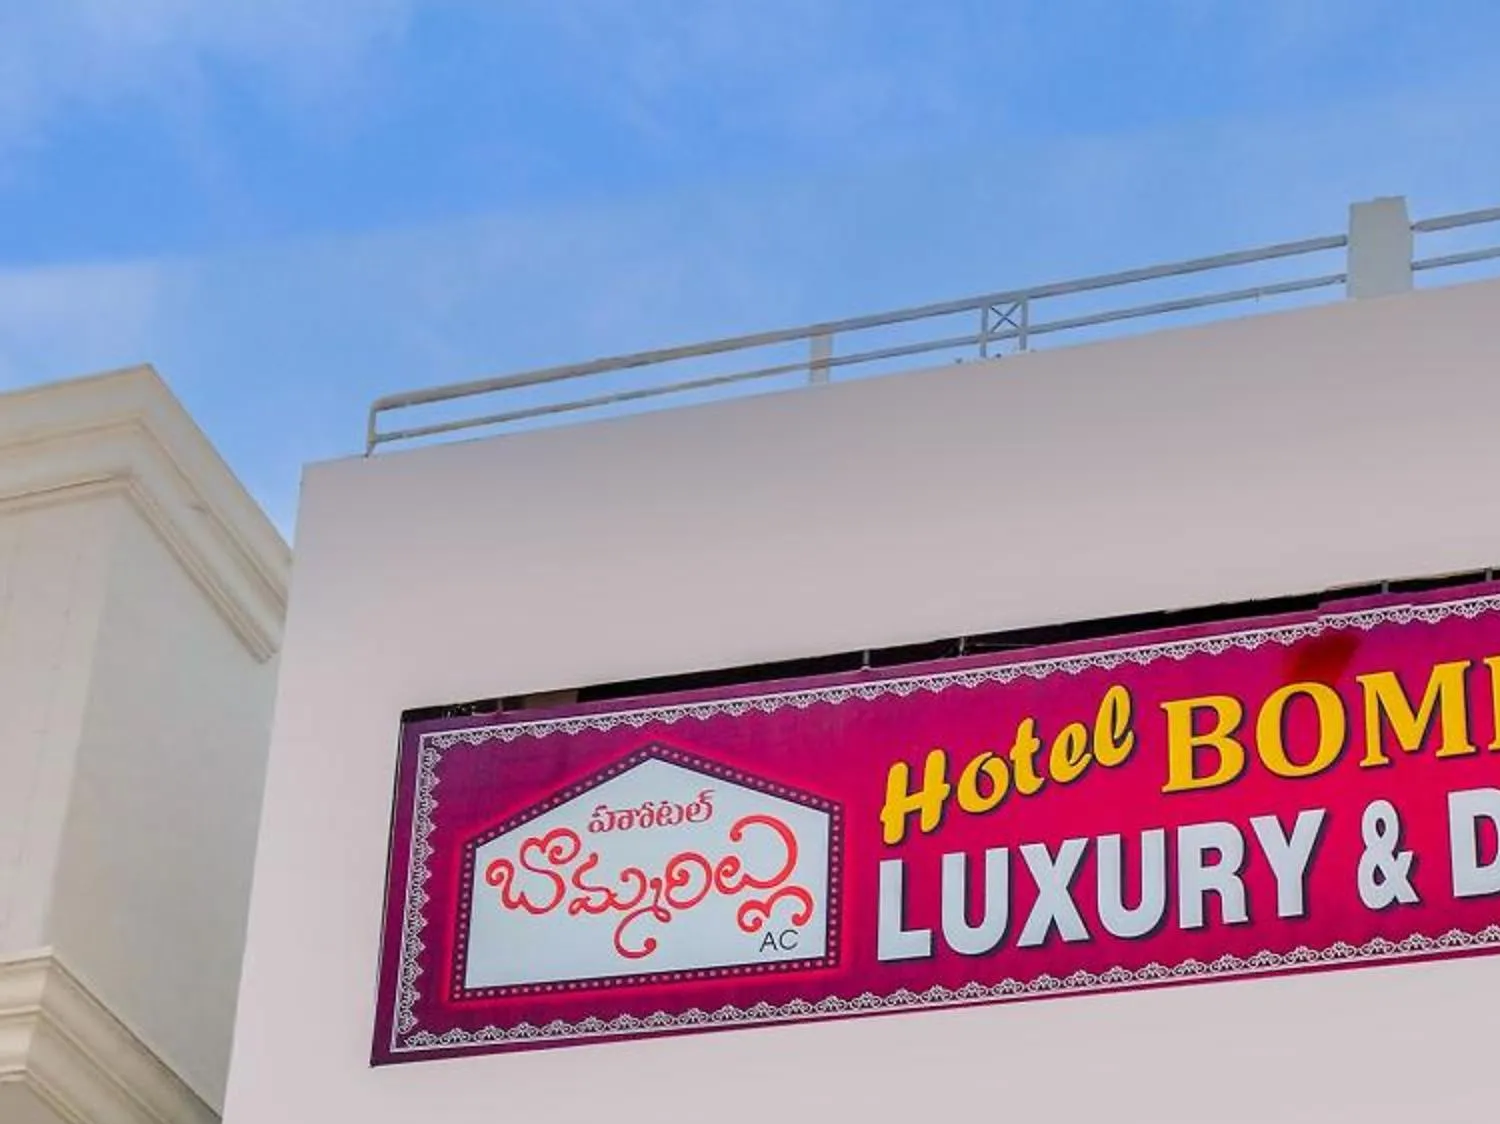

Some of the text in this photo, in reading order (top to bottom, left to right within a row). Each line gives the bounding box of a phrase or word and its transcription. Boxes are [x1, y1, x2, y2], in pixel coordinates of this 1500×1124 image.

[880, 684, 1134, 844] Hotel
[758, 928, 801, 953] AC
[877, 808, 1327, 962] LUXURY
[1357, 799, 1419, 911] &
